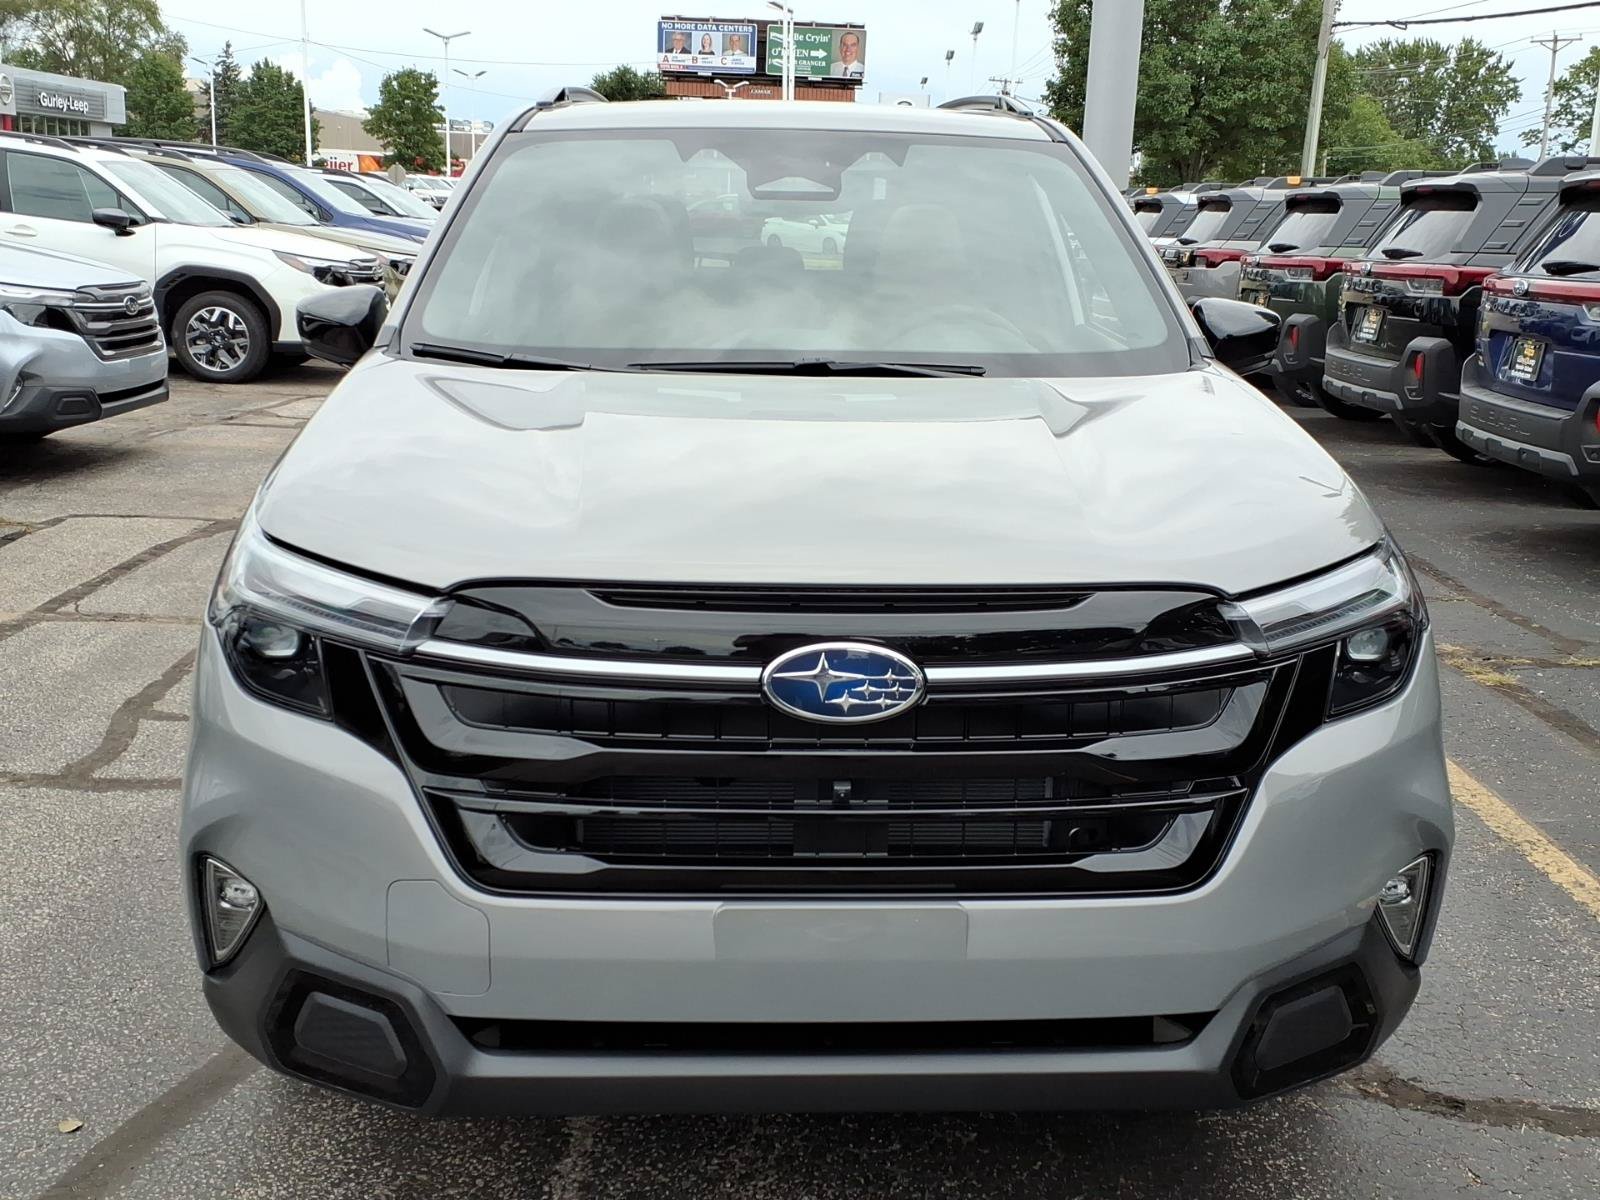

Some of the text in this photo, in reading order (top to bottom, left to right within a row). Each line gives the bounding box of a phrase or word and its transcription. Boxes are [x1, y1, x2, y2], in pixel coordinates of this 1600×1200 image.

[674, 23, 696, 31] MORE
[718, 25, 753, 33] CENTERS
[805, 34, 831, 44] Cryin'
[662, 55, 670, 63] A
[691, 56, 698, 64] B
[720, 57, 728, 65] C
[39, 92, 89, 114] Gurley-Leep
